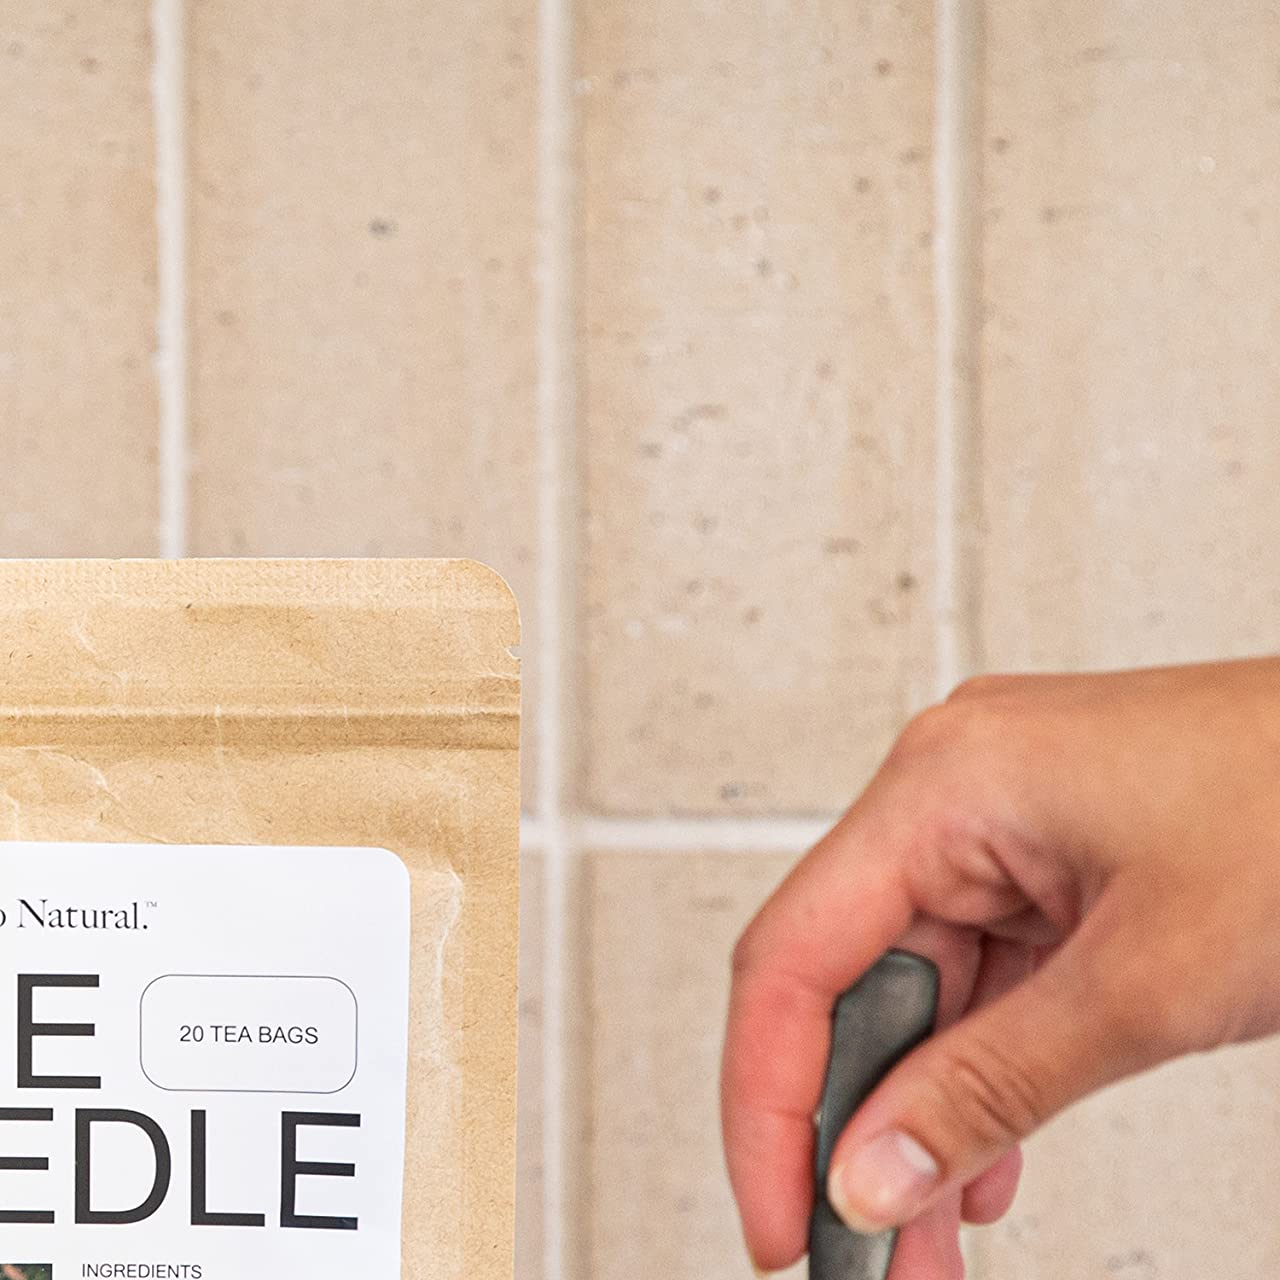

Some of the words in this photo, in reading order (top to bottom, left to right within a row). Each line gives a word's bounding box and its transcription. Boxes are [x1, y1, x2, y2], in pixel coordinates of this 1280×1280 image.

[179, 1024, 205, 1043] 20
[209, 1024, 253, 1043] TEA
[258, 1025, 319, 1045] BAGS
[82, 1263, 203, 1280] INGREDIENTS
